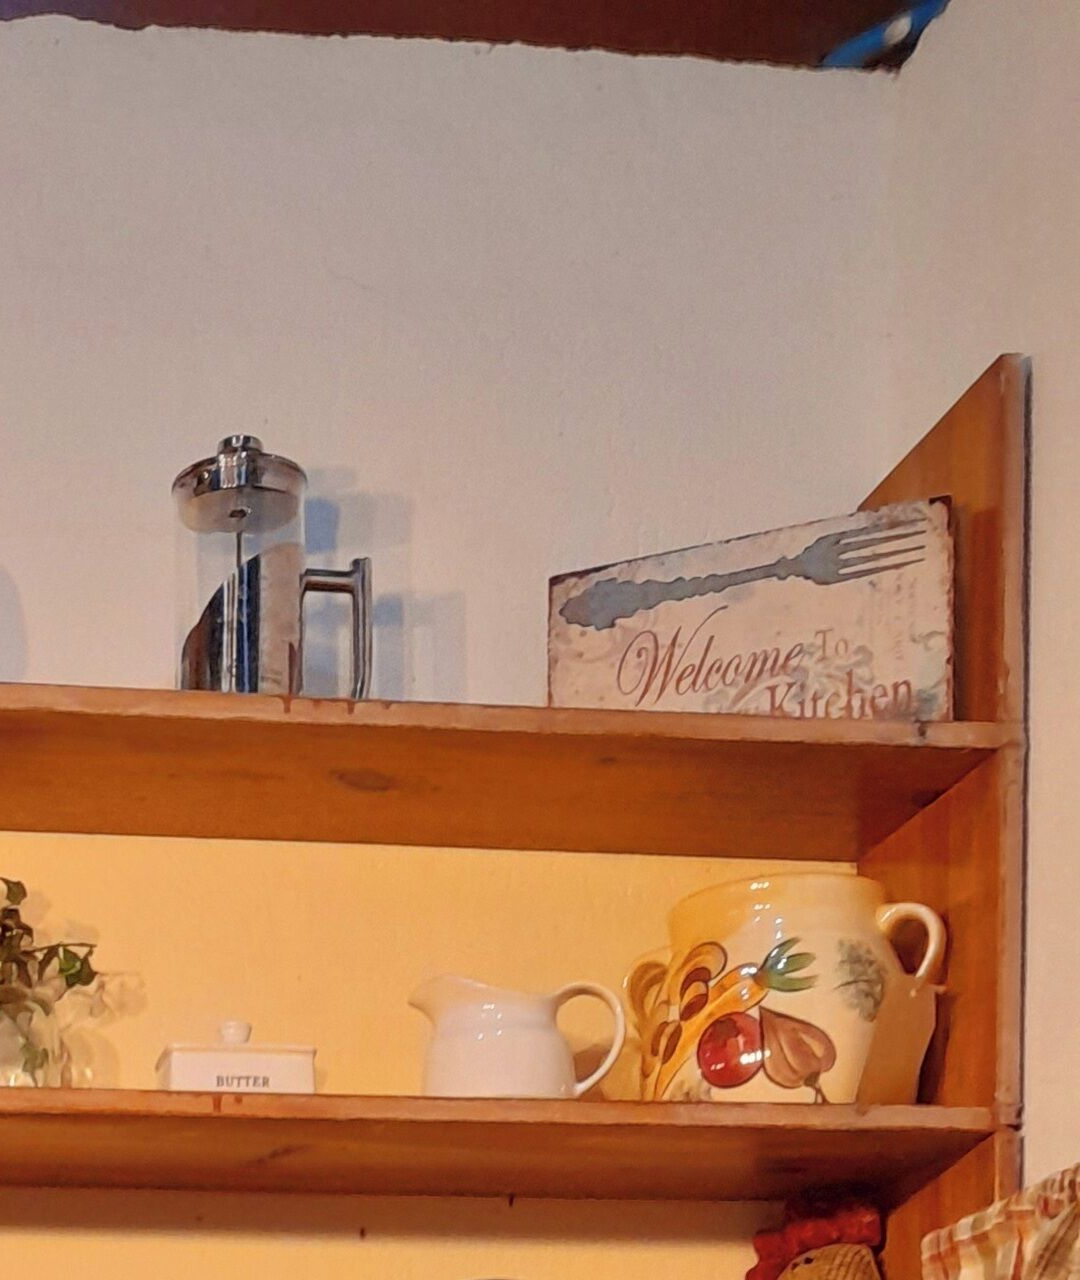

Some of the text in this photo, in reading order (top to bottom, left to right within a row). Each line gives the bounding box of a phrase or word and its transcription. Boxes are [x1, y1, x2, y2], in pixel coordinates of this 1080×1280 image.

[617, 605, 849, 708] Welcome To
[766, 670, 913, 720] Kitchen
[215, 1075, 270, 1088] BUTTER
